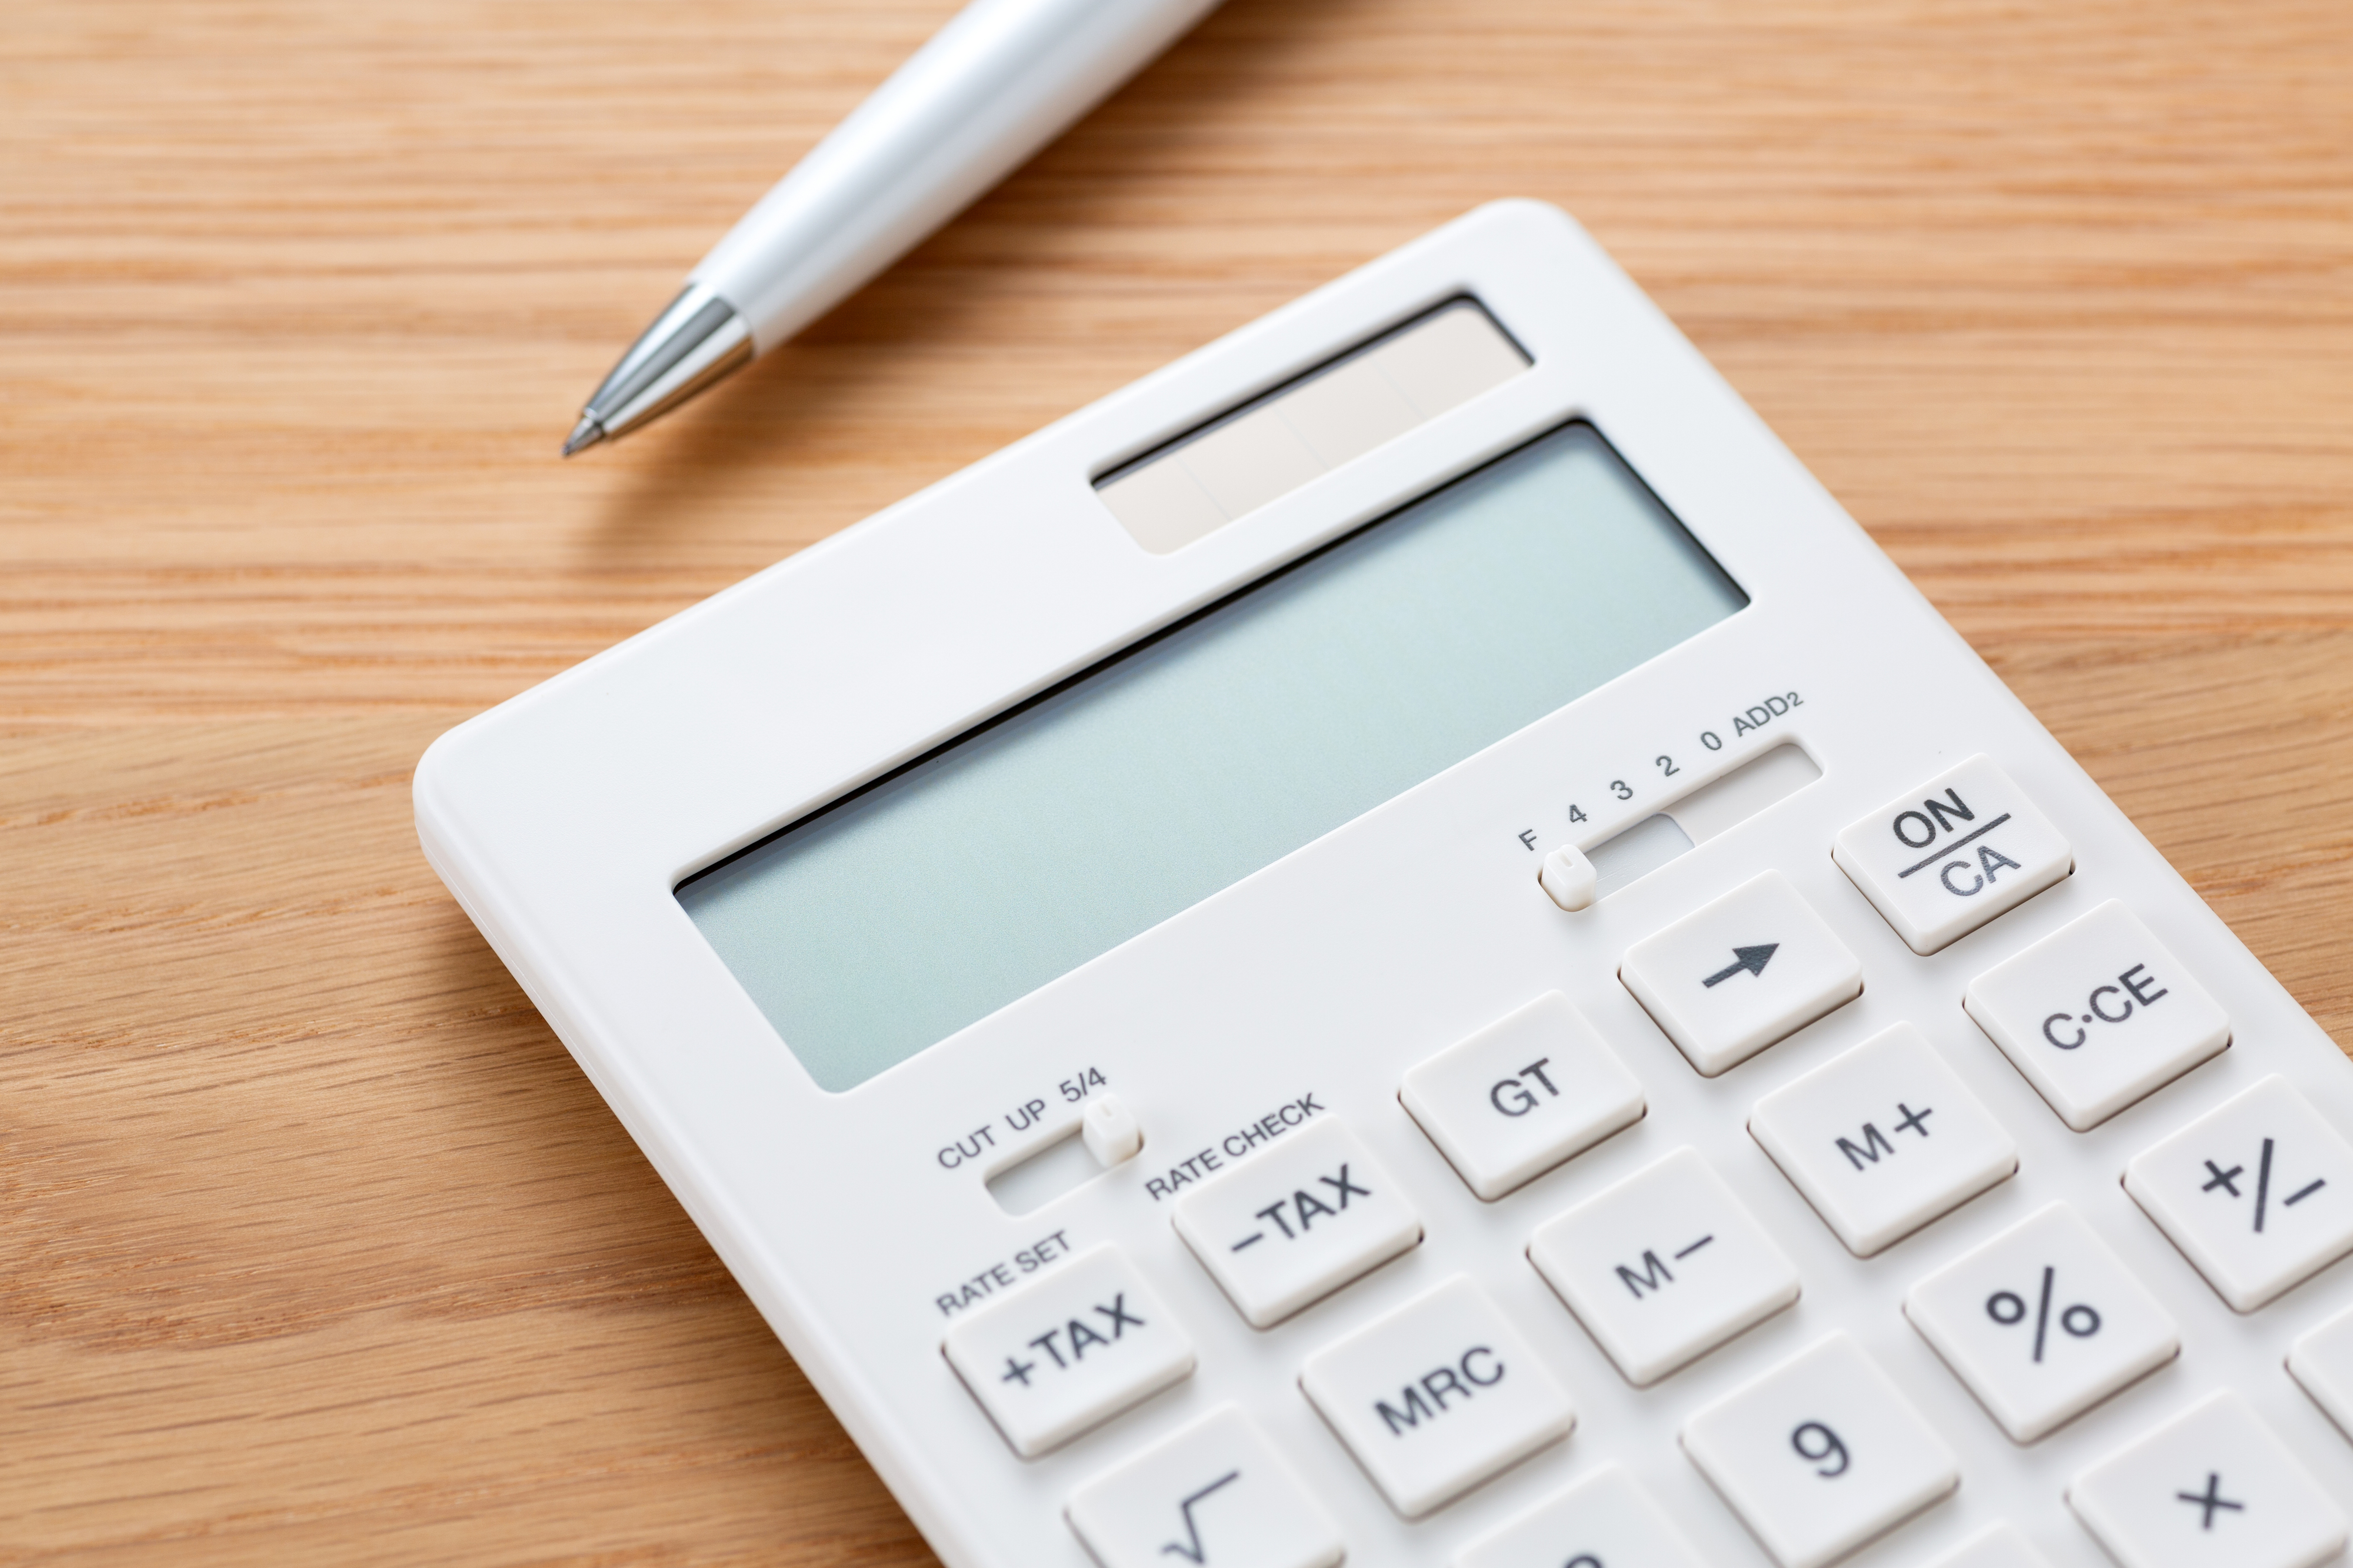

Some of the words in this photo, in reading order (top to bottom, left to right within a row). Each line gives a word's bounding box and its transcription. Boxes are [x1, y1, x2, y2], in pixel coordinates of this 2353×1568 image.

[1518, 829, 1537, 852] F
[1568, 803, 1588, 823] 4
[1610, 780, 1634, 800] 3
[1655, 755, 1680, 777] 2
[1892, 788, 1975, 848] ON
[1940, 845, 2021, 896] CA
[936, 1125, 999, 1170] CUT
[1005, 1098, 1046, 1132] UP
[1059, 1066, 1107, 1103] 5/4
[1490, 1057, 1559, 1117] GT
[1144, 1147, 1224, 1202] RATE
[1222, 1092, 1326, 1157] CHECK
[1835, 1102, 1932, 1172] M+
[935, 1262, 1016, 1317] RATE
[1015, 1230, 1072, 1275] SET
[1985, 1266, 2102, 1363] %
[1001, 1292, 1145, 1386] +TAX
[1374, 1346, 1505, 1436] MRC
[1791, 1421, 1850, 1478] 9
